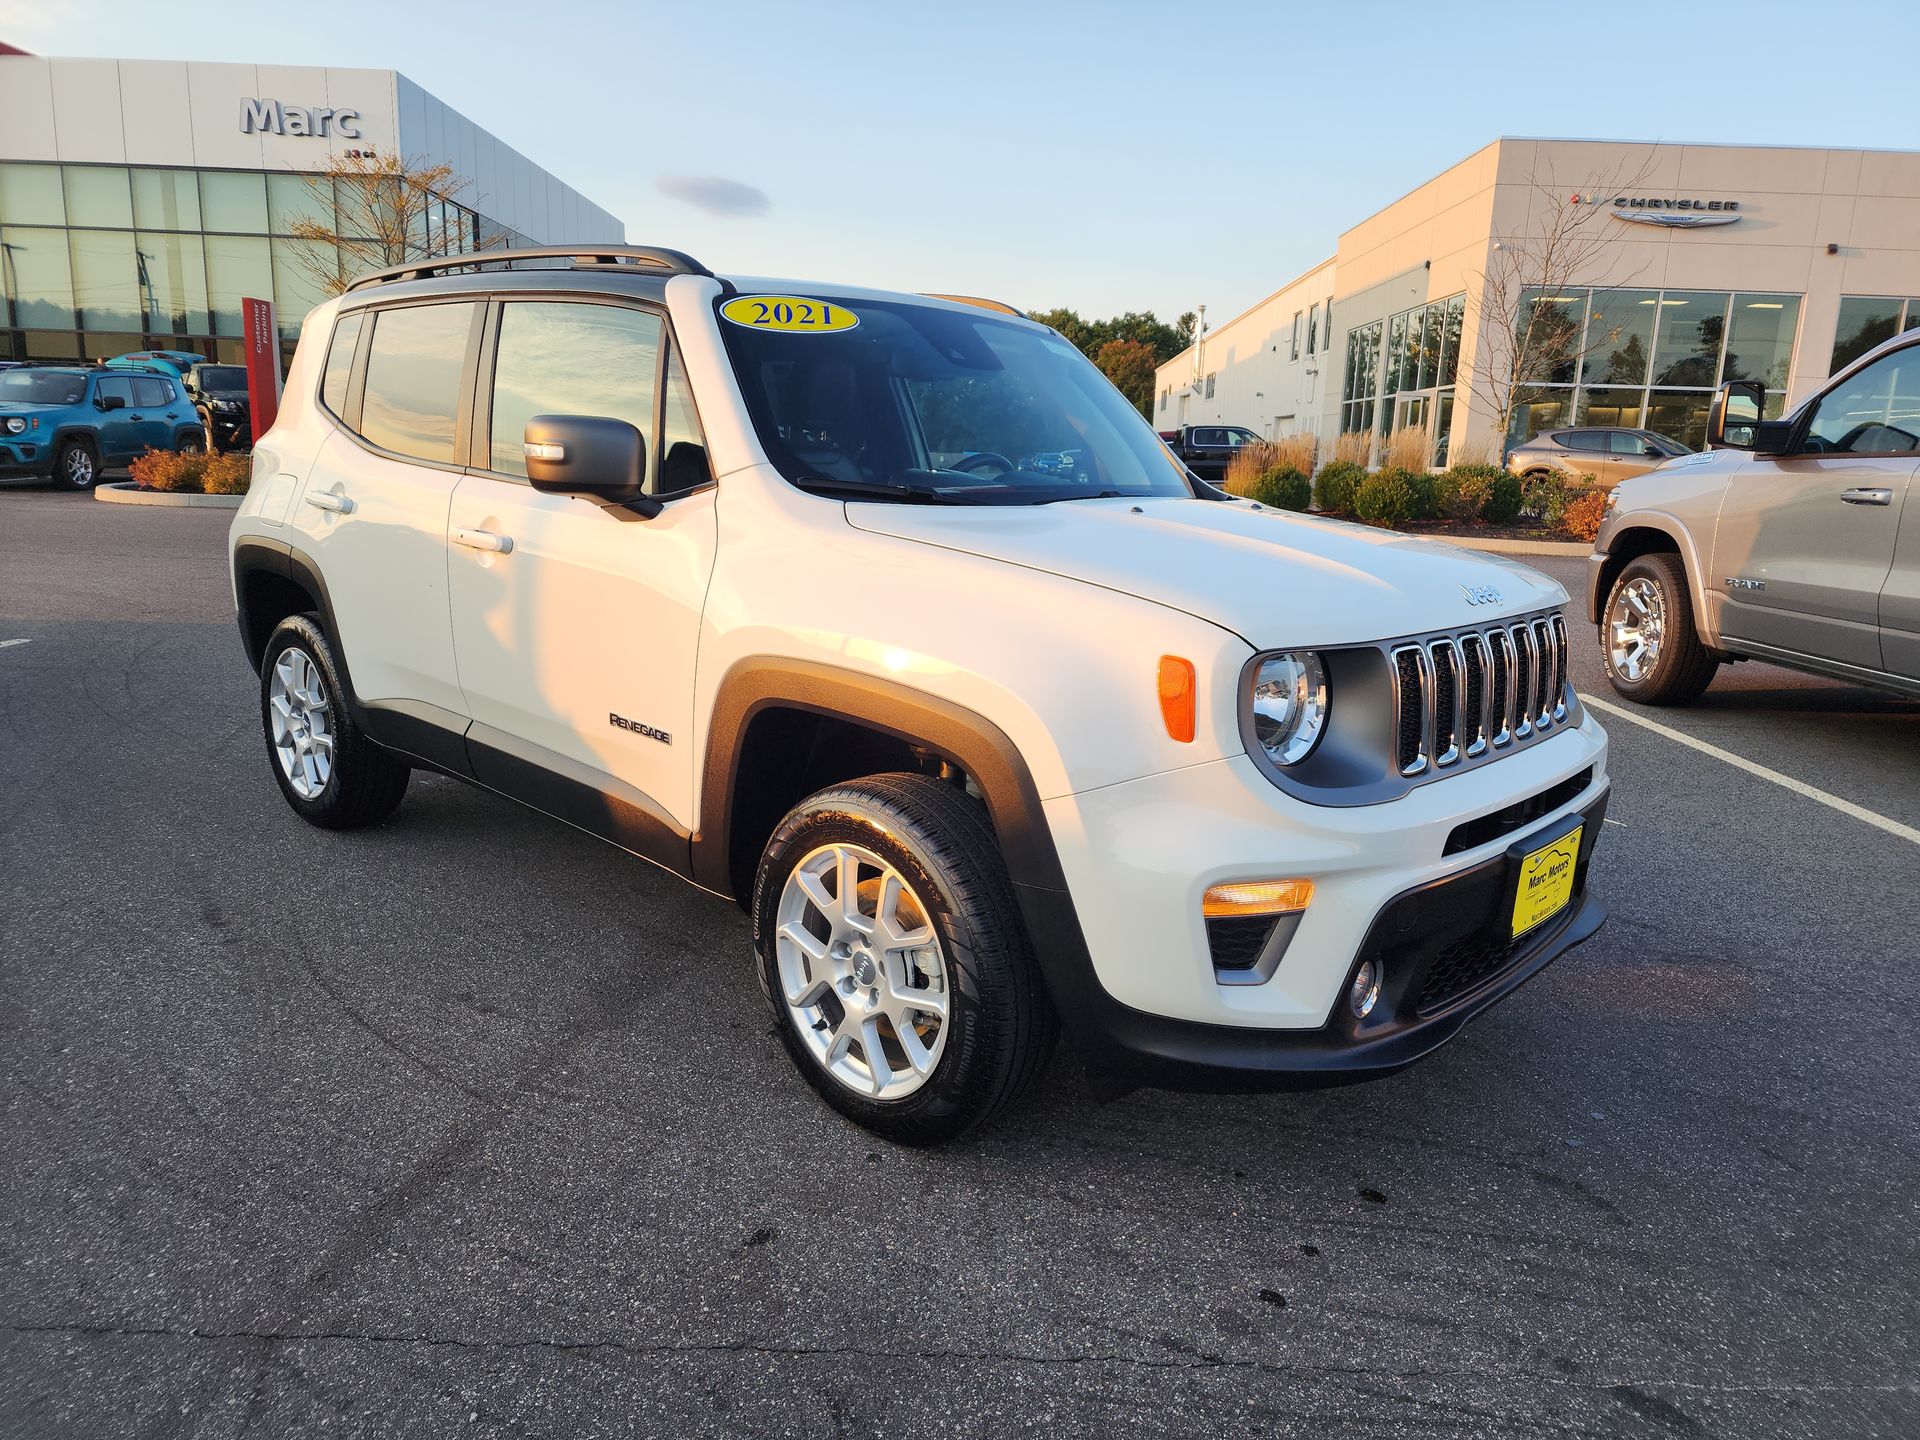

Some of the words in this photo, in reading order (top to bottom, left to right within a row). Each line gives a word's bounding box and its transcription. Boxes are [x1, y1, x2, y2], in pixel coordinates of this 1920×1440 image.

[240, 98, 360, 138] Marc
[1614, 197, 1739, 210] CHRYSLER
[254, 303, 262, 353] Customer
[751, 303, 831, 324] 2021
[1458, 584, 1503, 606] Jeep
[609, 712, 672, 746] RENEGADE
[1528, 873, 1547, 890] Marc
[1548, 859, 1569, 879] Motors
